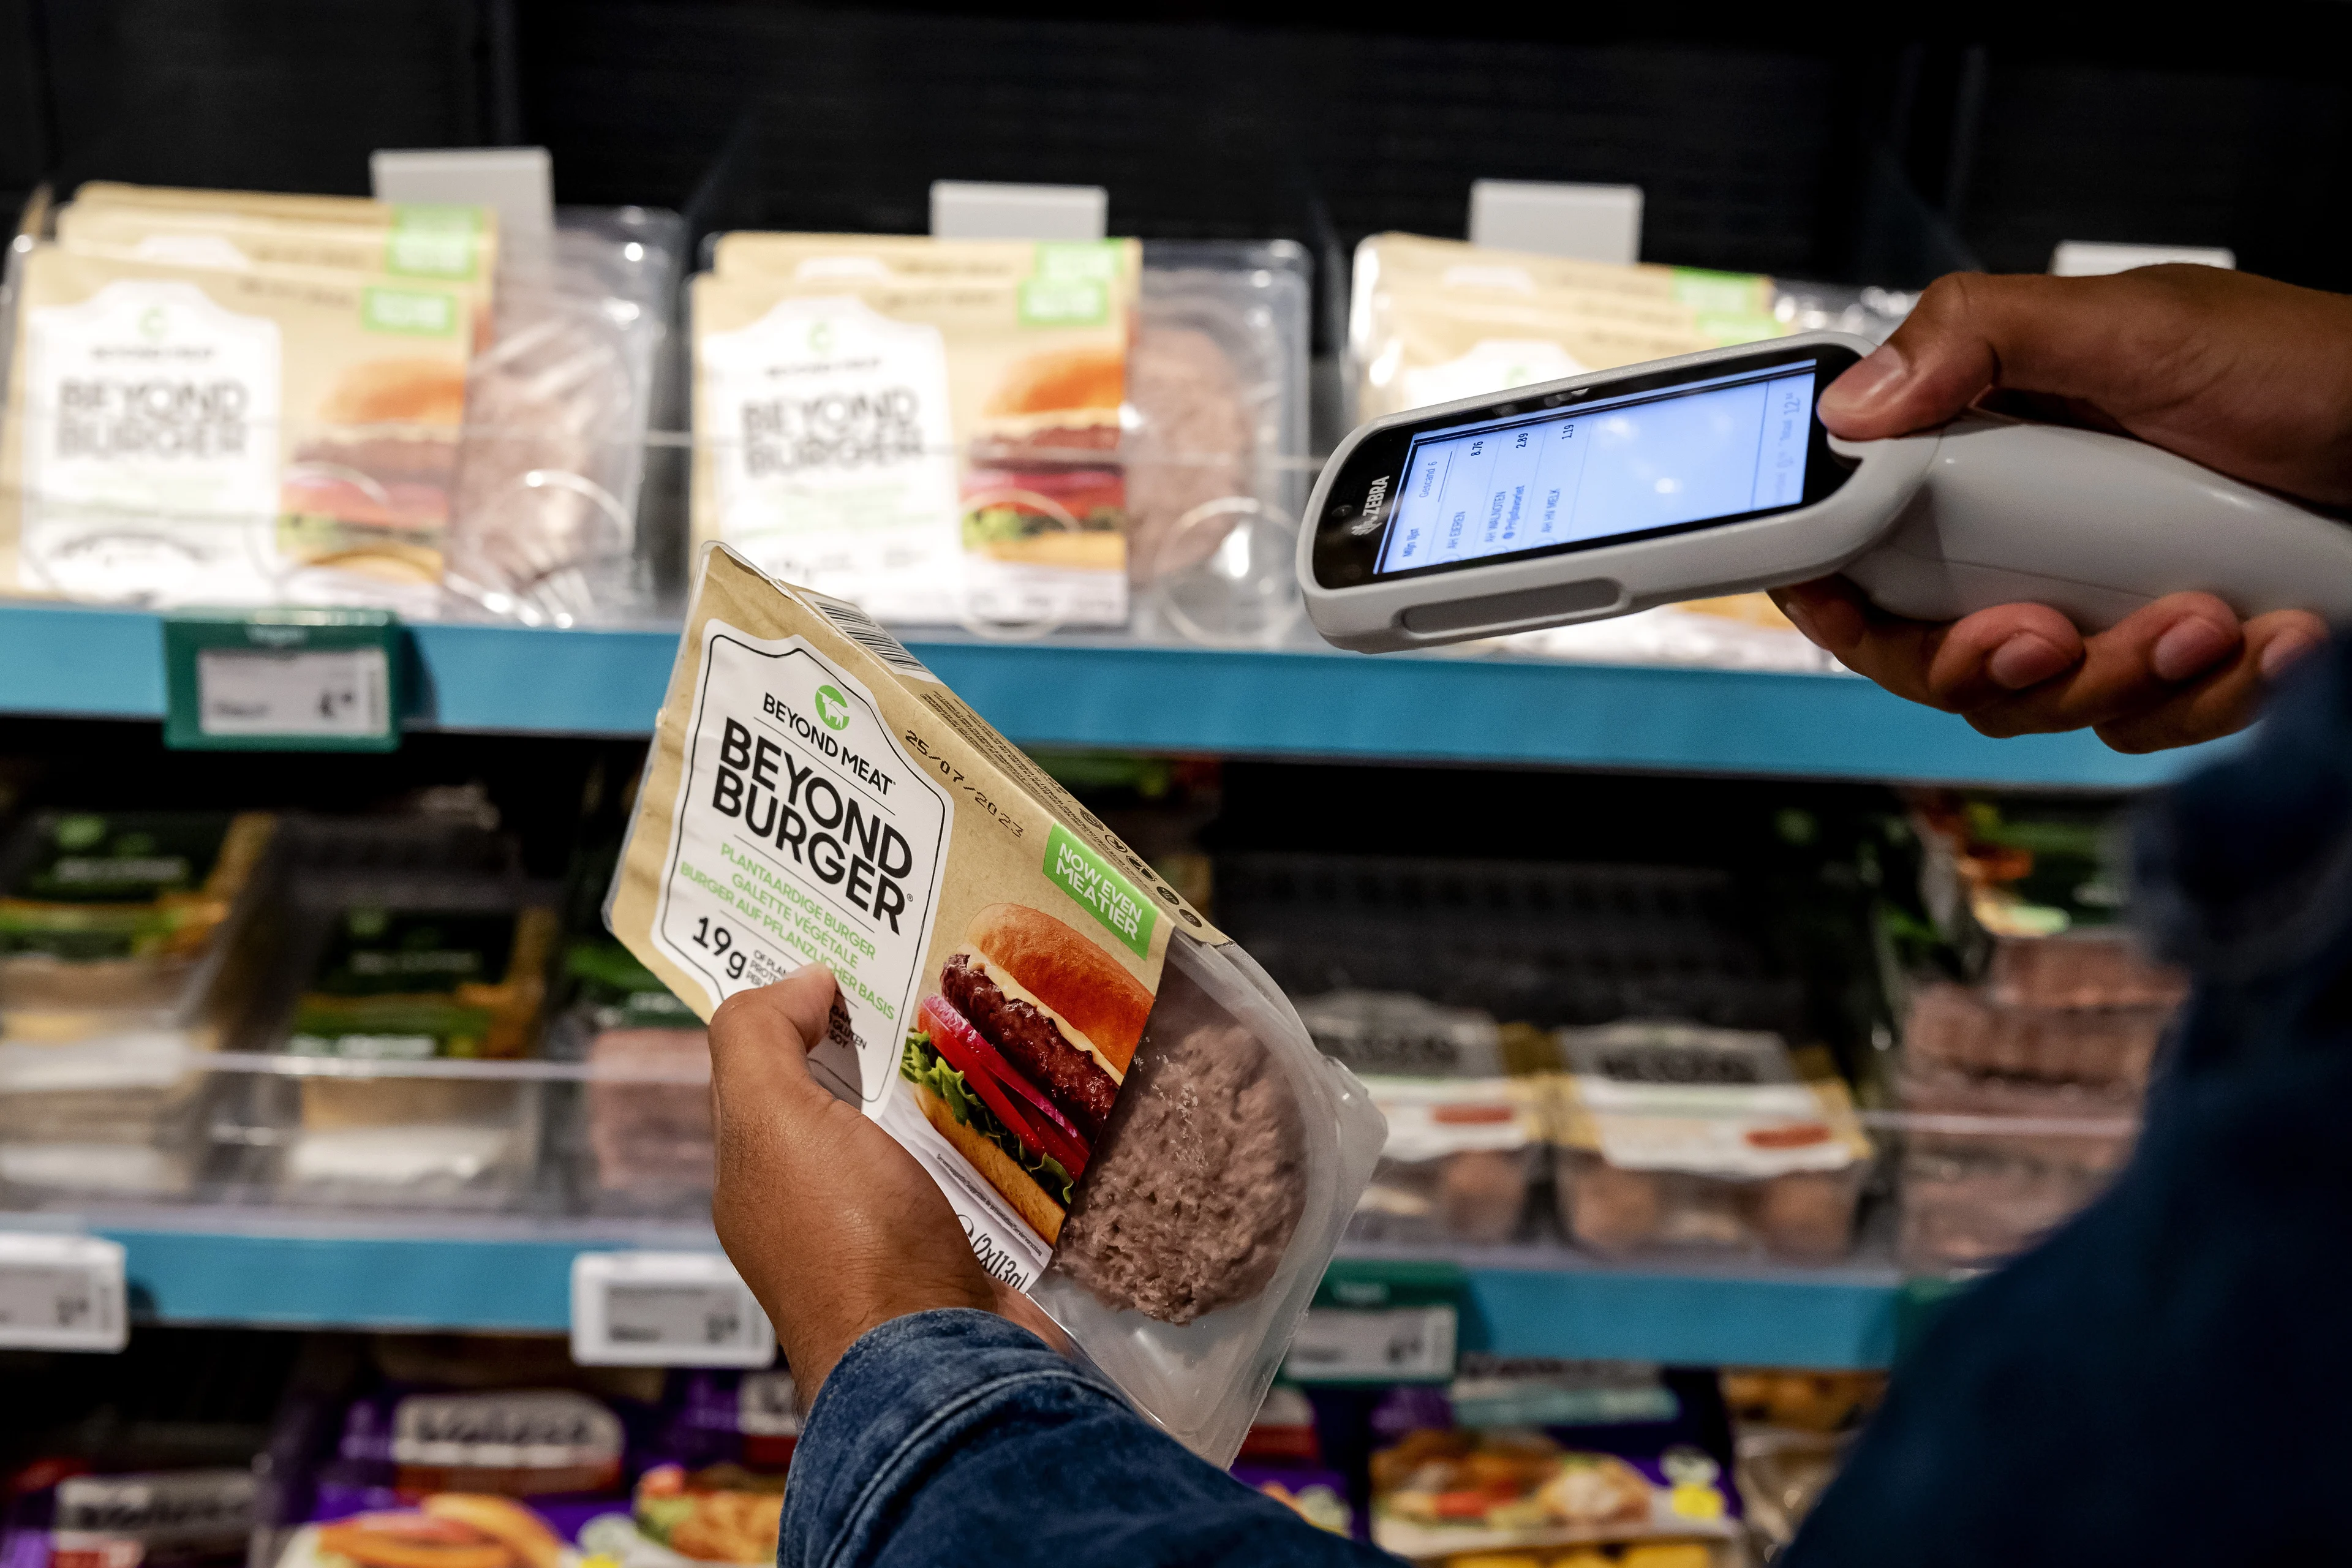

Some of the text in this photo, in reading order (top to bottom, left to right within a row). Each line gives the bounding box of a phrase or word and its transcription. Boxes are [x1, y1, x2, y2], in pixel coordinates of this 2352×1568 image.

[1471, 441, 1483, 456] 8.76
[1516, 432, 1528, 448] 2.89
[1562, 424, 1574, 440] 1.19
[1362, 475, 1390, 516] ZEBRA
[1419, 468, 1436, 498] Gescand
[763, 692, 893, 796] BEYOND MEAT
[905, 730, 1024, 839] 25/07/2023
[720, 716, 912, 879] BEYOND
[712, 764, 905, 936] BURGER
[1059, 843, 1102, 886] NOW
[1101, 879, 1142, 922] EVEN
[680, 861, 734, 905] BURGER
[736, 898, 761, 921] AUF
[763, 914, 857, 992] PFLANZLICHER
[858, 982, 895, 1020] BASIS
[721, 843, 876, 960] PLANTAARDIGE BURGER
[733, 873, 859, 969] GALETTE VÉGÉTALE
[1056, 858, 1137, 941] MEATIER
[692, 916, 747, 980] 19g
